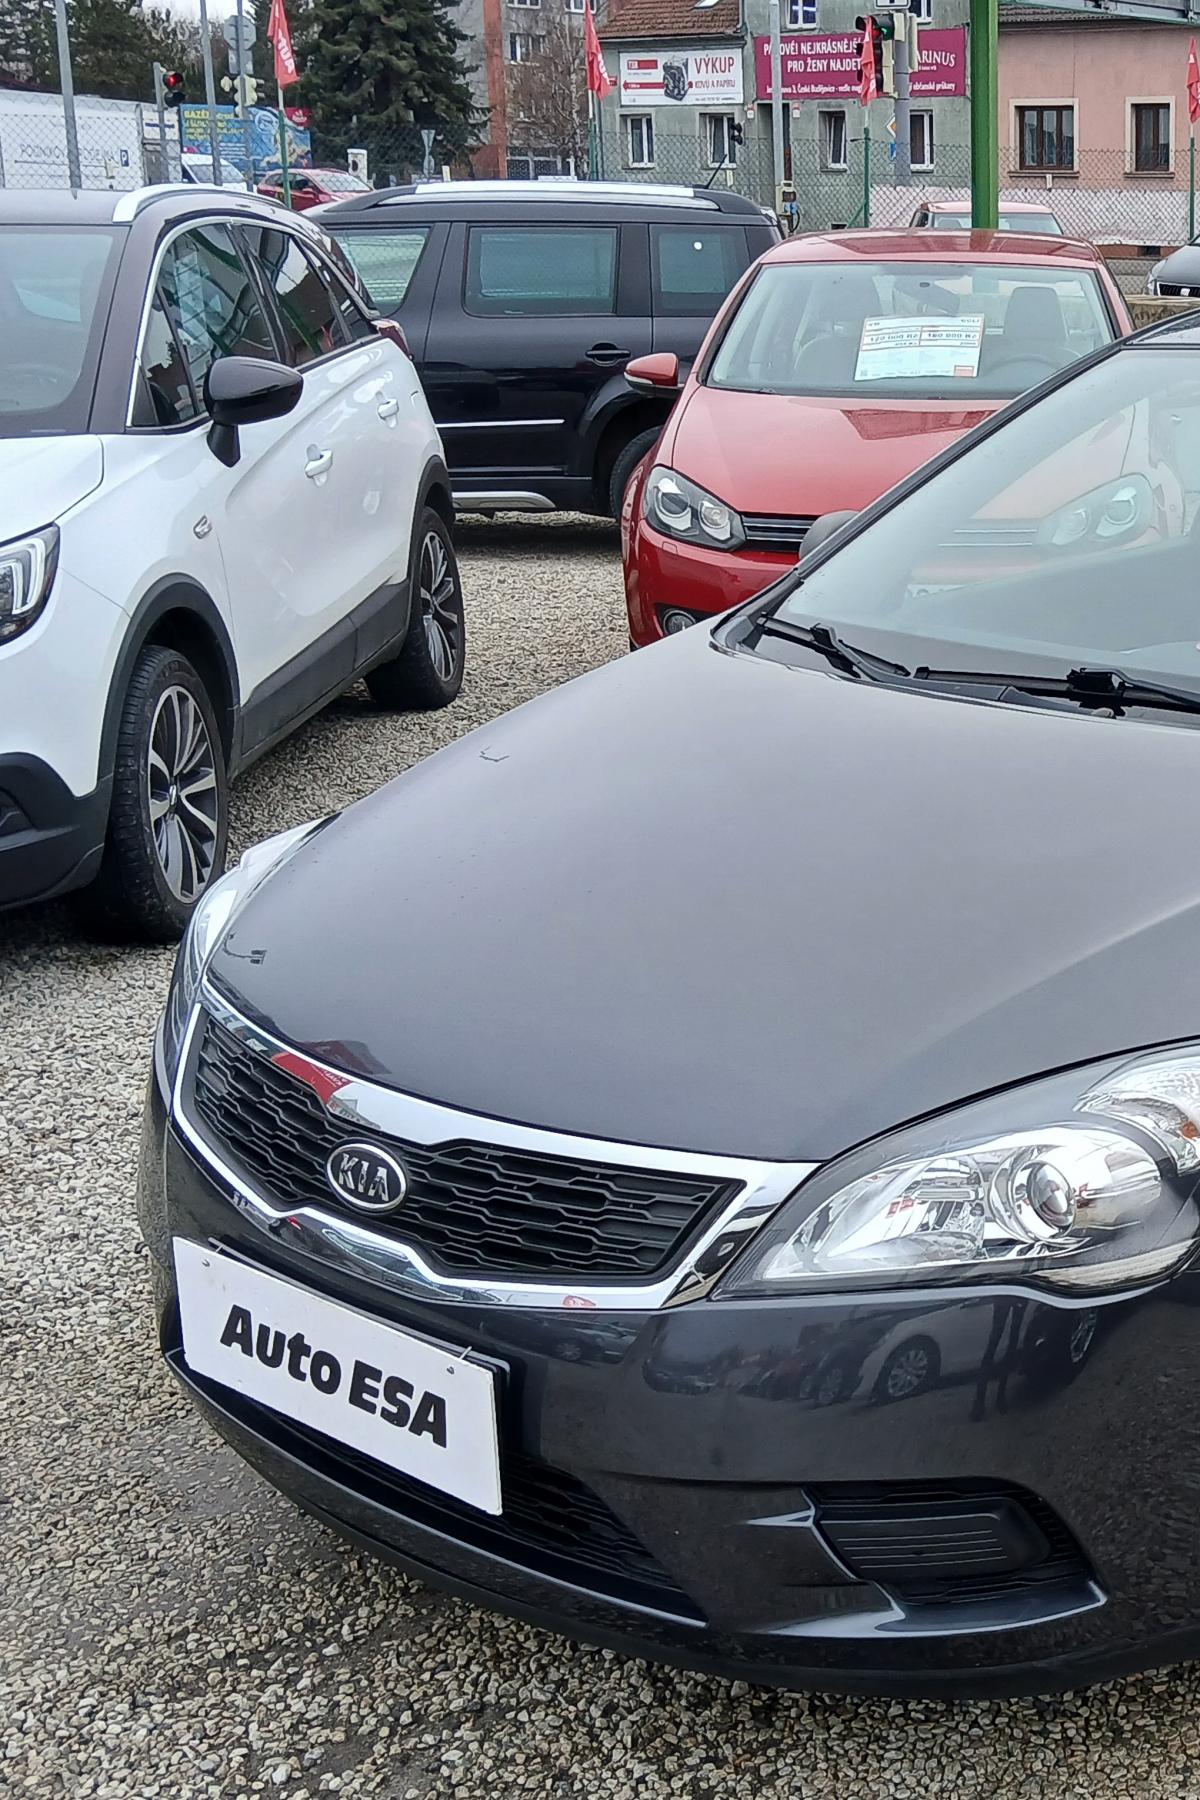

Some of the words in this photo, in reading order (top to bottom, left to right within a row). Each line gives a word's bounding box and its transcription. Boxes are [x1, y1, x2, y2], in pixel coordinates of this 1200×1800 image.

[800, 37, 862, 55] NEJKRÁSNĚJŠ
[694, 54, 735, 74] VÝKUP
[787, 60, 804, 73] PRO
[806, 57, 828, 72] ŽENY
[830, 58, 861, 71] NAJDET
[338, 1153, 390, 1202] KIA
[219, 1304, 342, 1396] Auto
[348, 1359, 448, 1450] ESA
